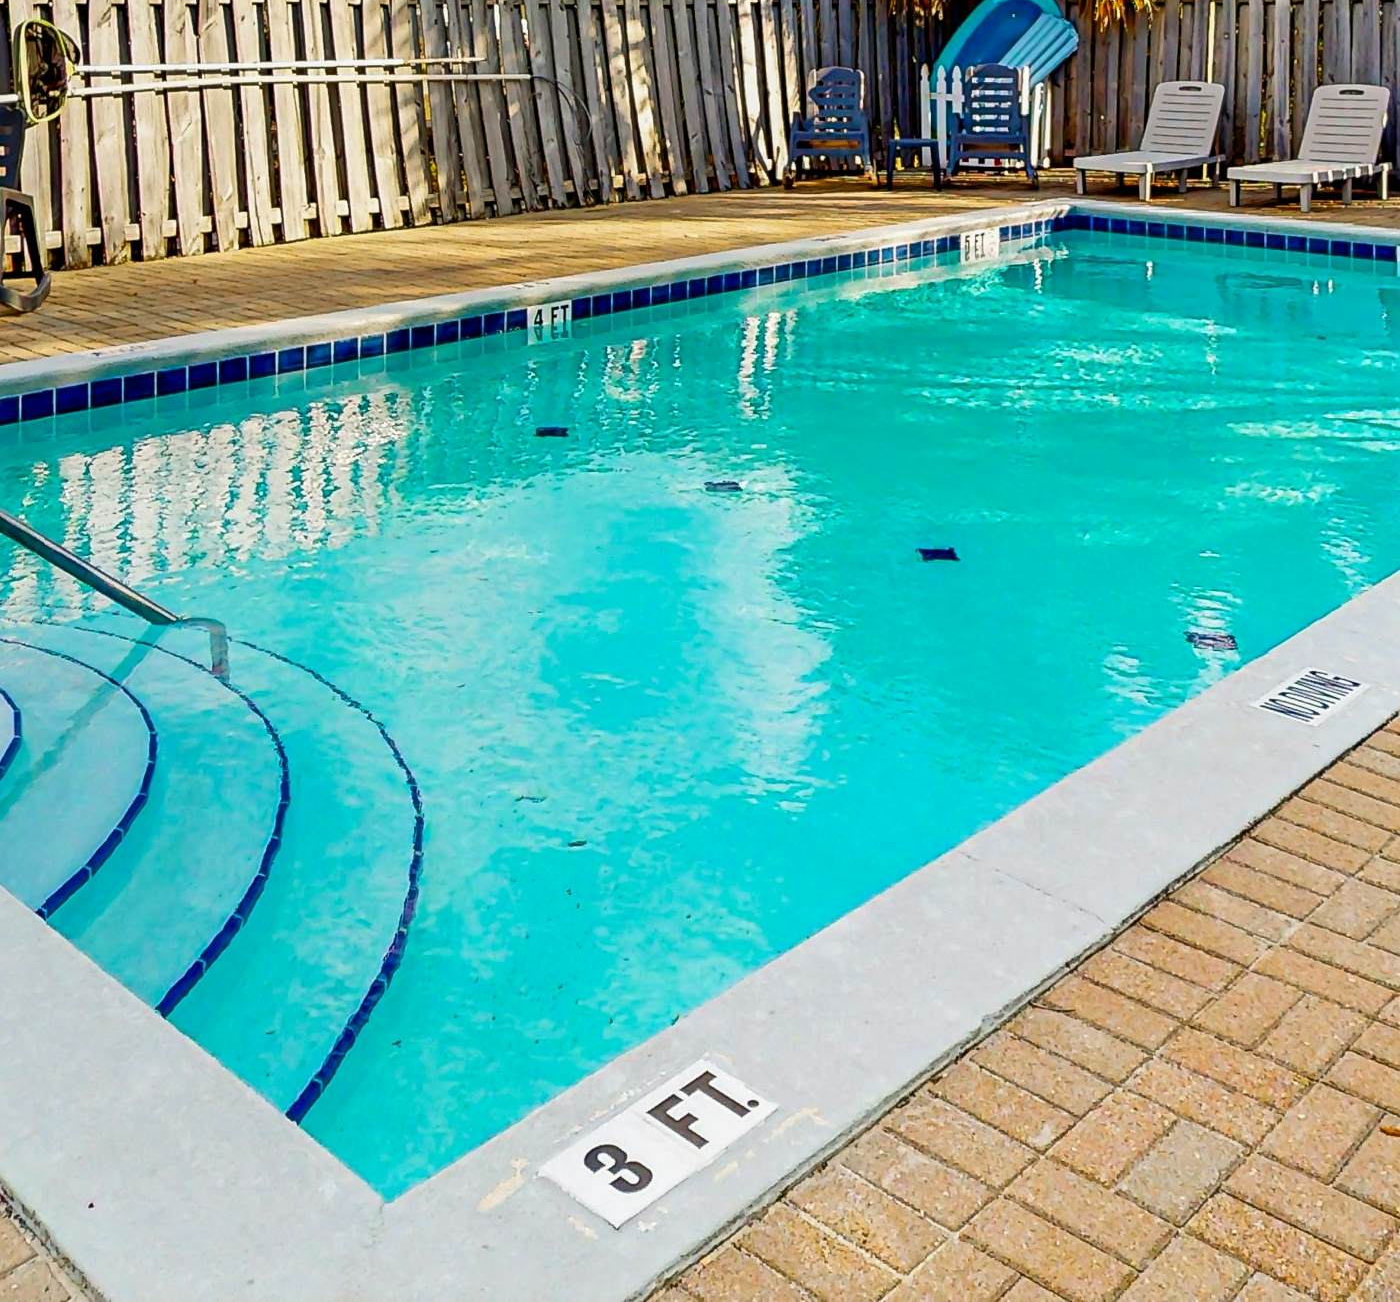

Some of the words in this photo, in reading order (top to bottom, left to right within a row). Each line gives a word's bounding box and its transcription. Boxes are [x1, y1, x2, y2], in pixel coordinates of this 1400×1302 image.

[534, 309, 543, 326] 4
[551, 304, 569, 328] FT
[1260, 686, 1321, 722] NO
[1278, 670, 1361, 710] DIVING
[584, 1144, 653, 1194] 3
[646, 1070, 760, 1149] FT.
